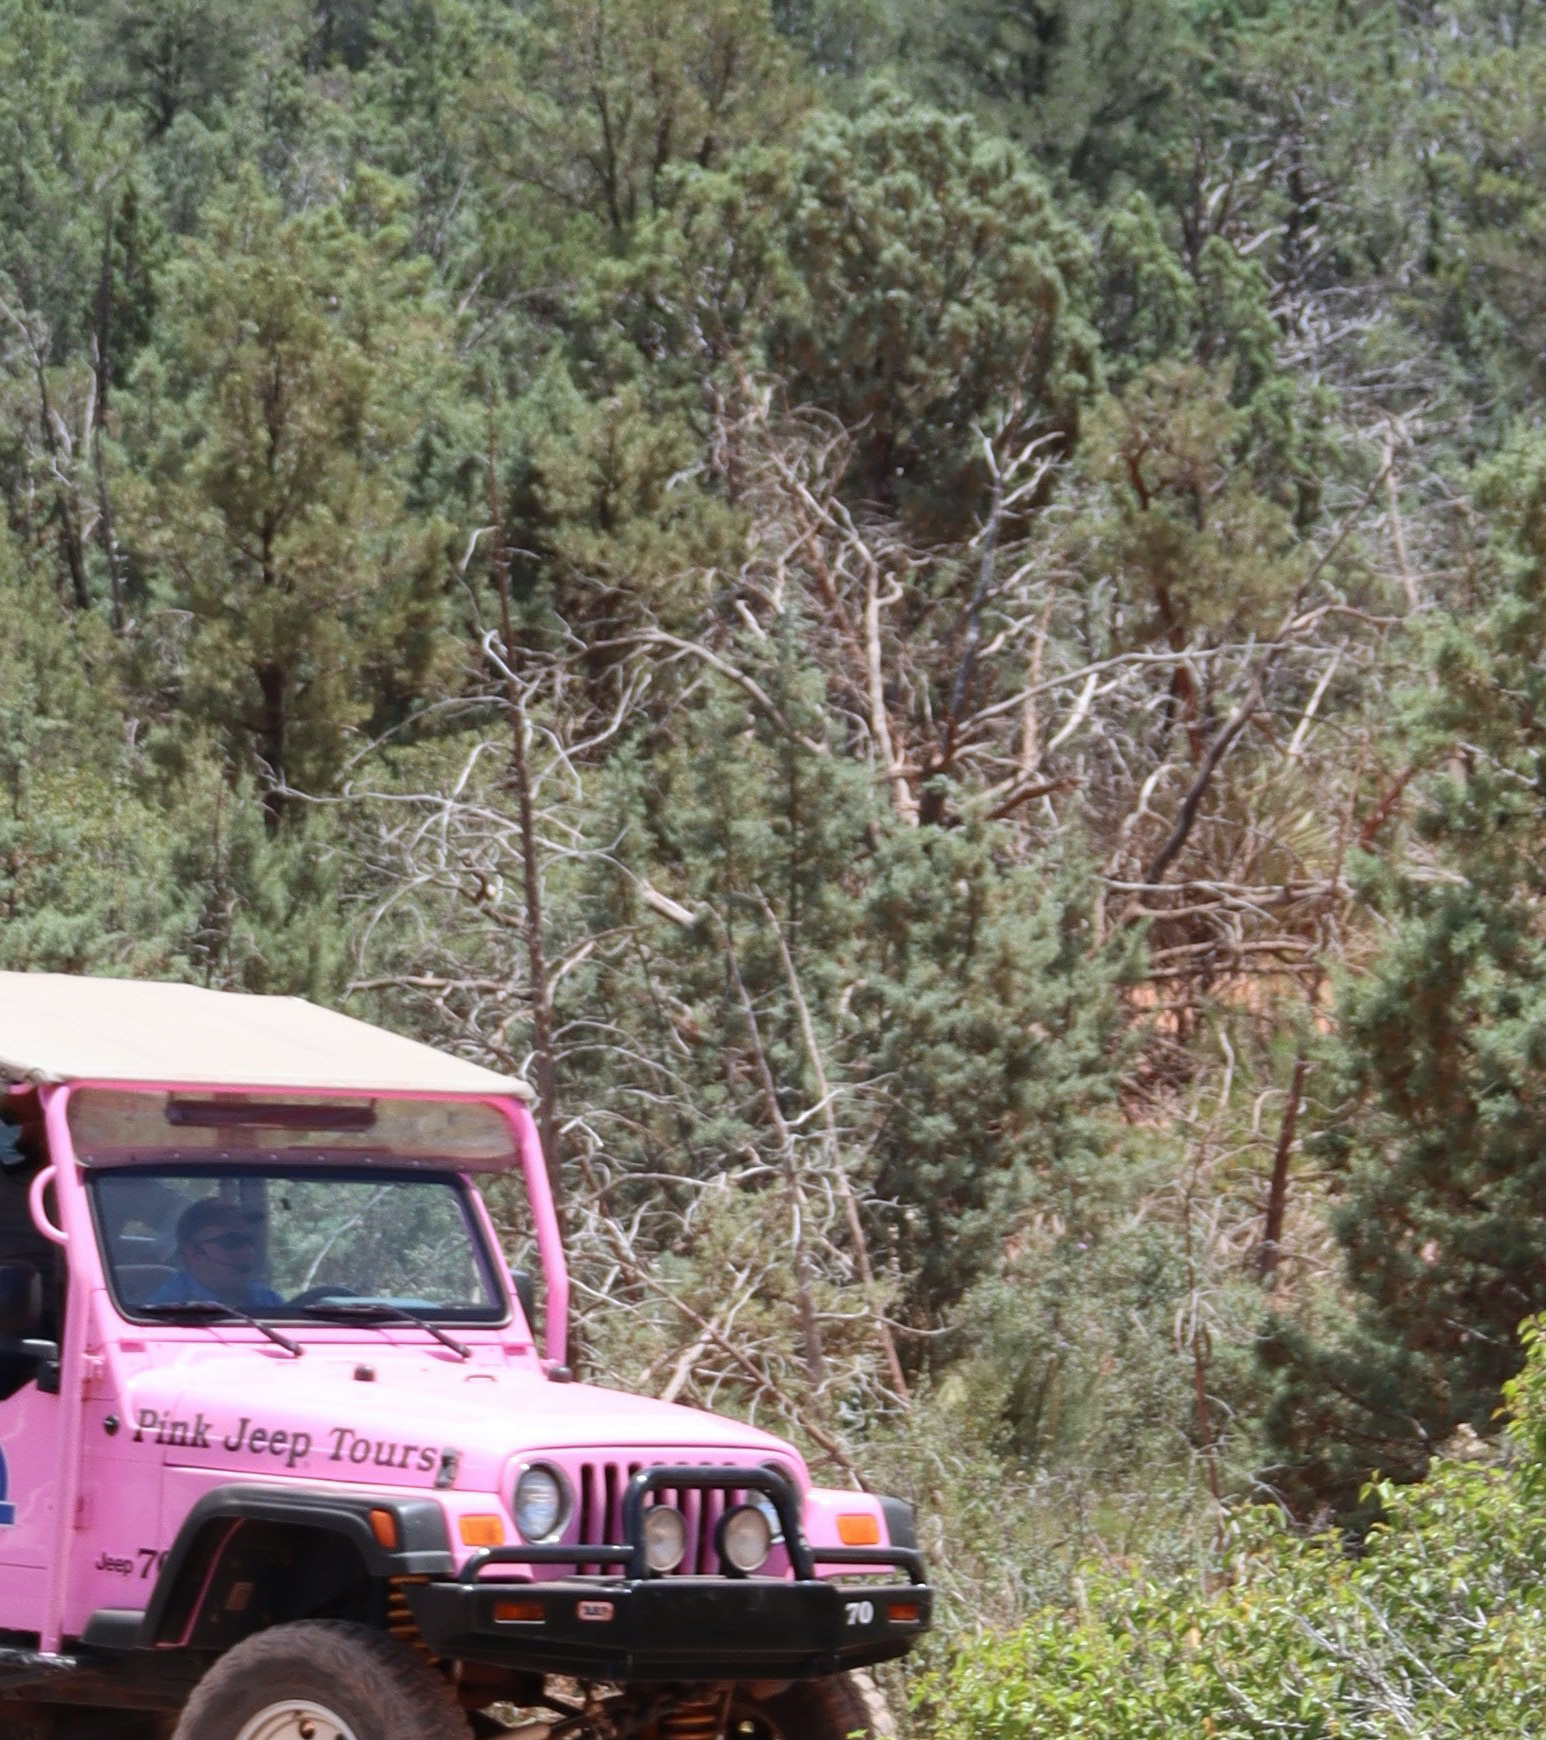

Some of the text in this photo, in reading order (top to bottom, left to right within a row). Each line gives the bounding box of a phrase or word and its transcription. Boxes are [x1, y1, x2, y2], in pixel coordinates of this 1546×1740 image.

[132, 1408, 437, 1473] Pink Jeep Tours
[95, 1552, 133, 1577] Jeep
[844, 1600, 874, 1625] 70
